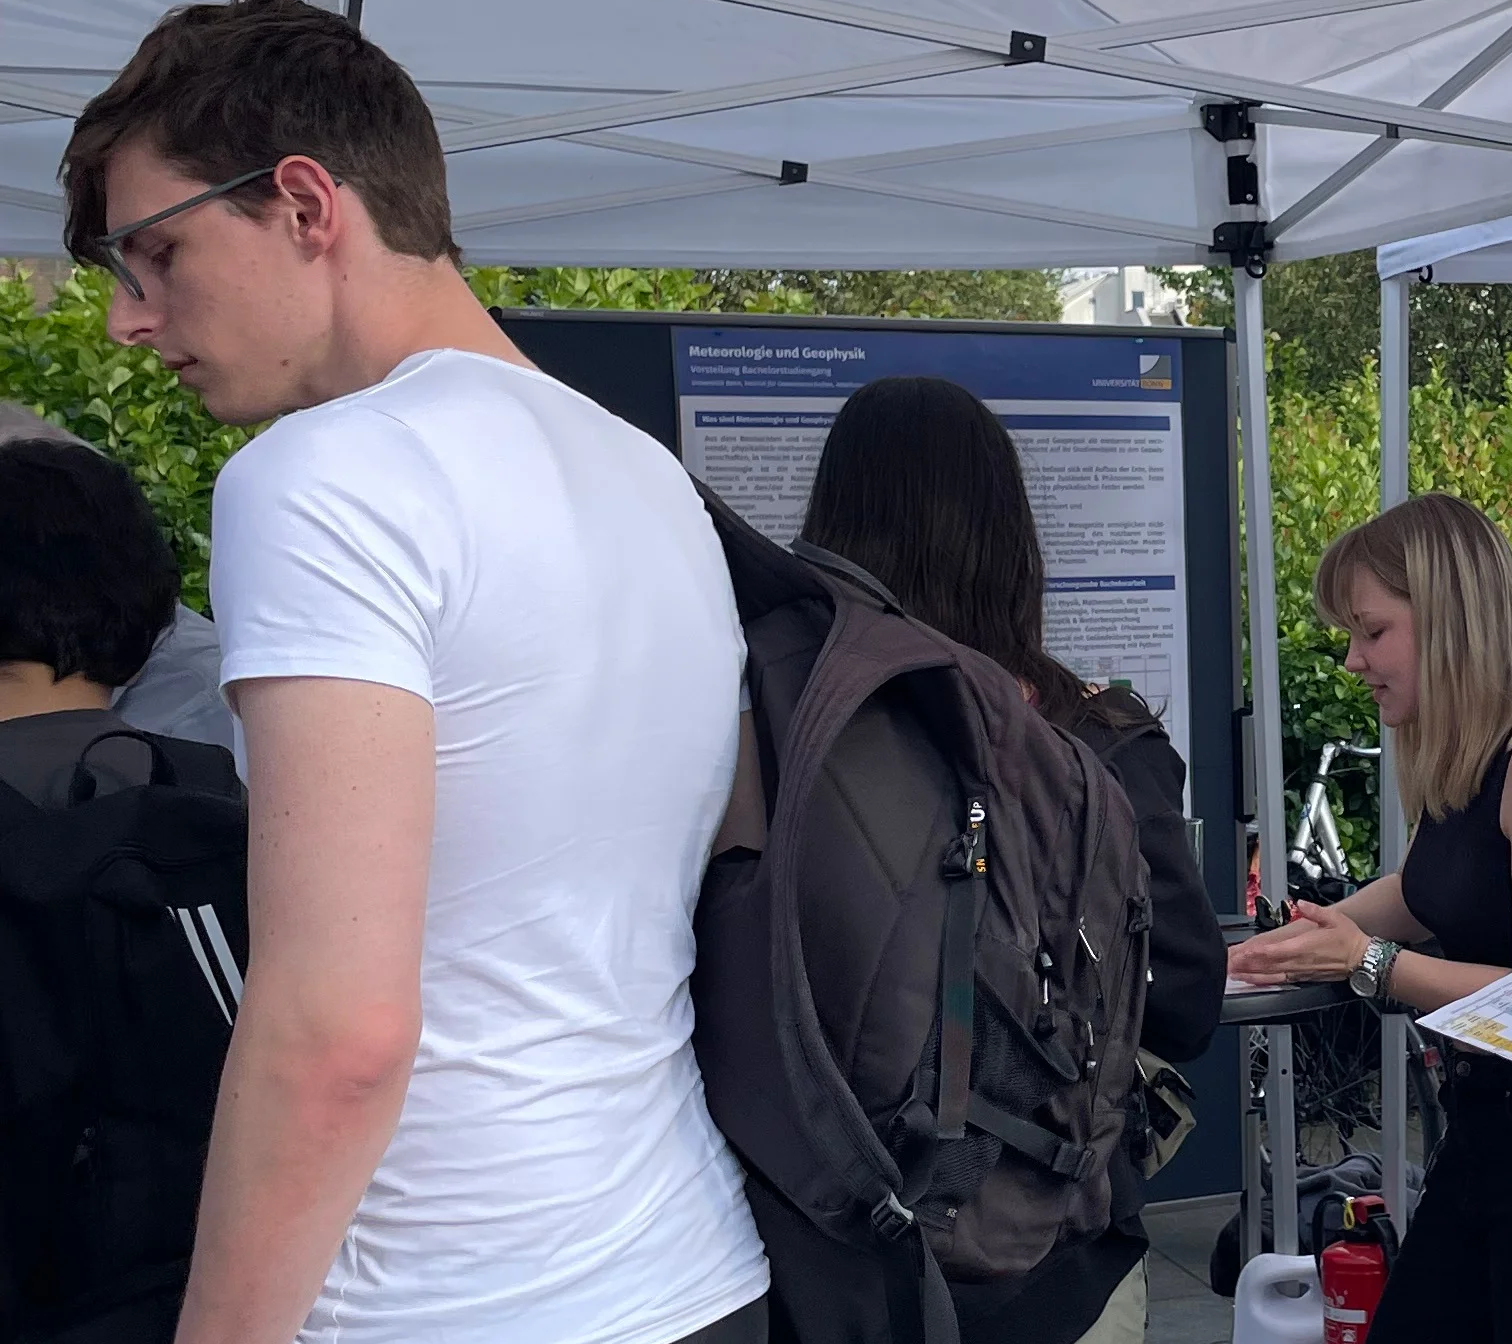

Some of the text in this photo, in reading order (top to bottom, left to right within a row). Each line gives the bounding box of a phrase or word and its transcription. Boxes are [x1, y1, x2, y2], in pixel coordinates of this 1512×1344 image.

[689, 345, 866, 362] Meteorologie und Geophysik
[690, 365, 740, 376] Vorstellung
